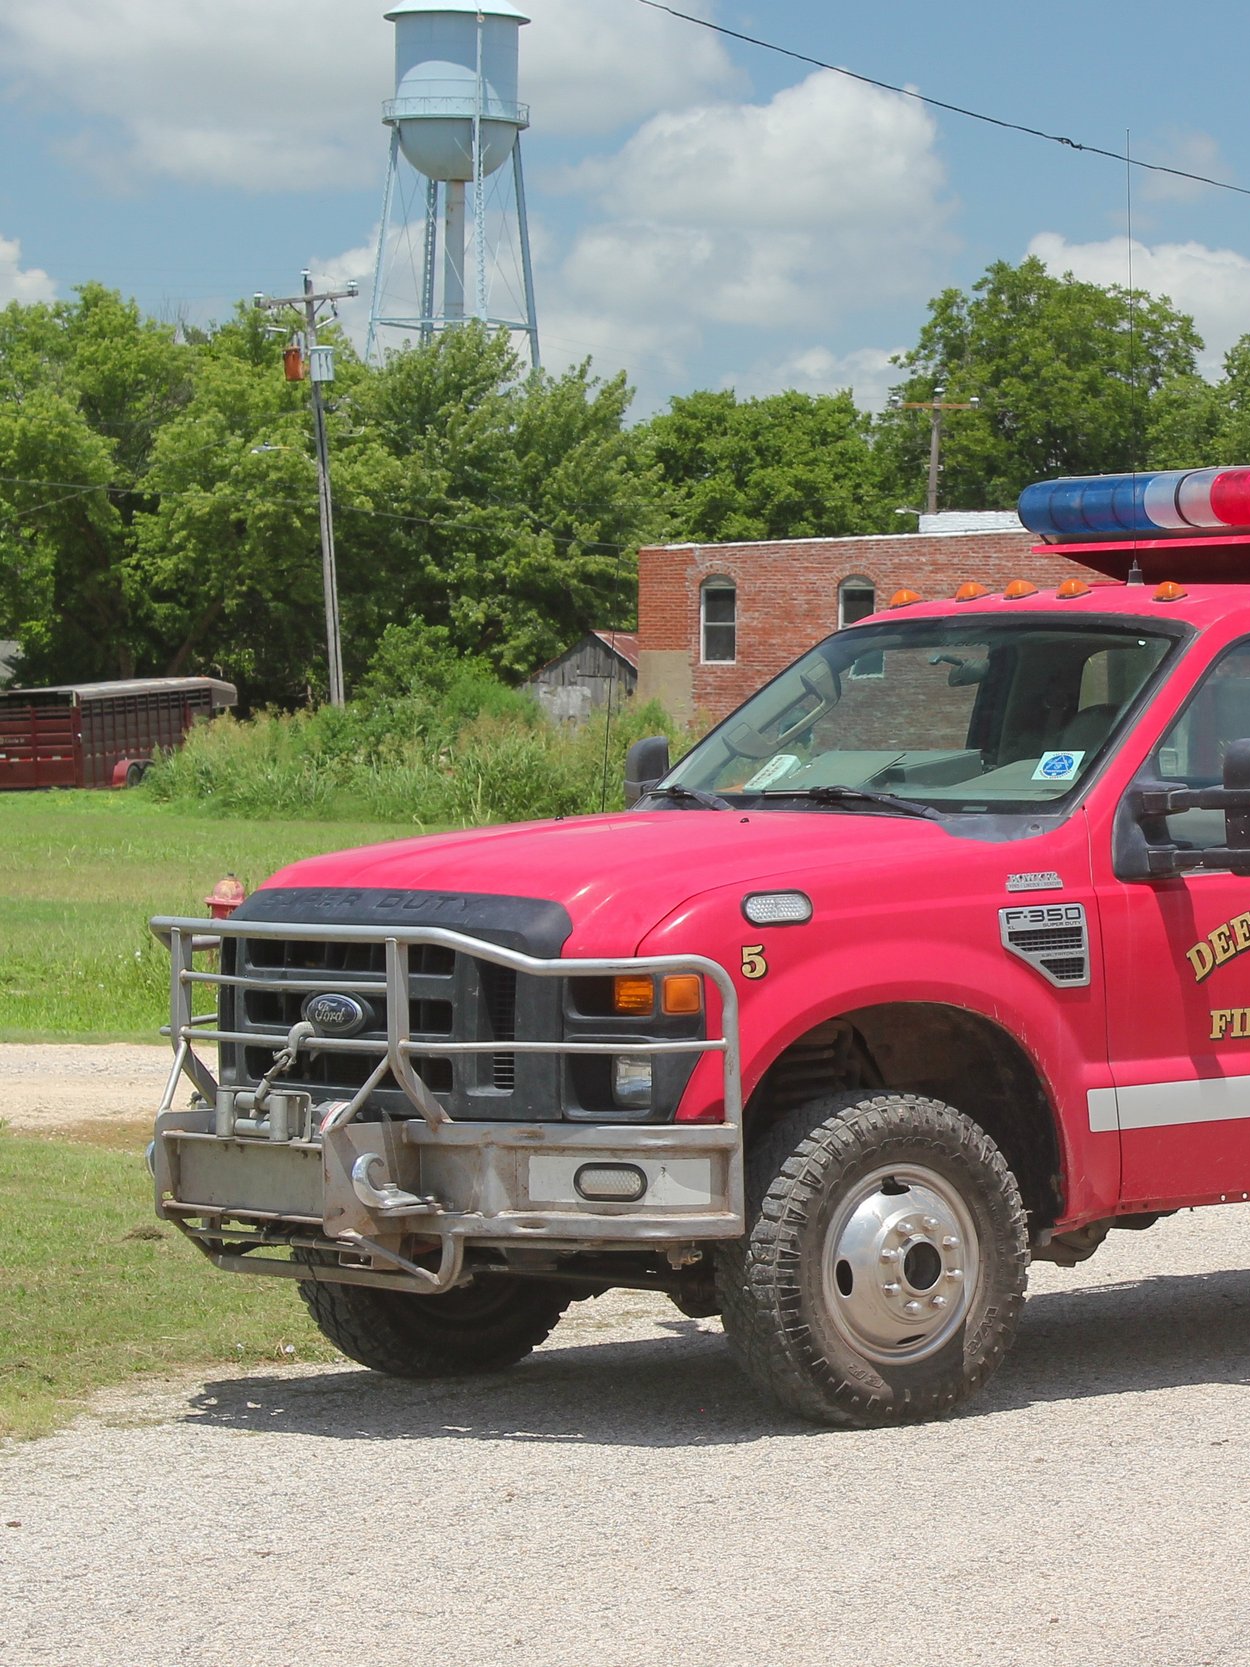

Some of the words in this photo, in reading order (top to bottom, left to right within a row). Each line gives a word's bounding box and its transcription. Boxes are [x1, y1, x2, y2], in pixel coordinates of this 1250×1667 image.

[375, 894, 480, 912] DUTY
[741, 944, 767, 980] 5
[315, 1000, 346, 1023] Ford
